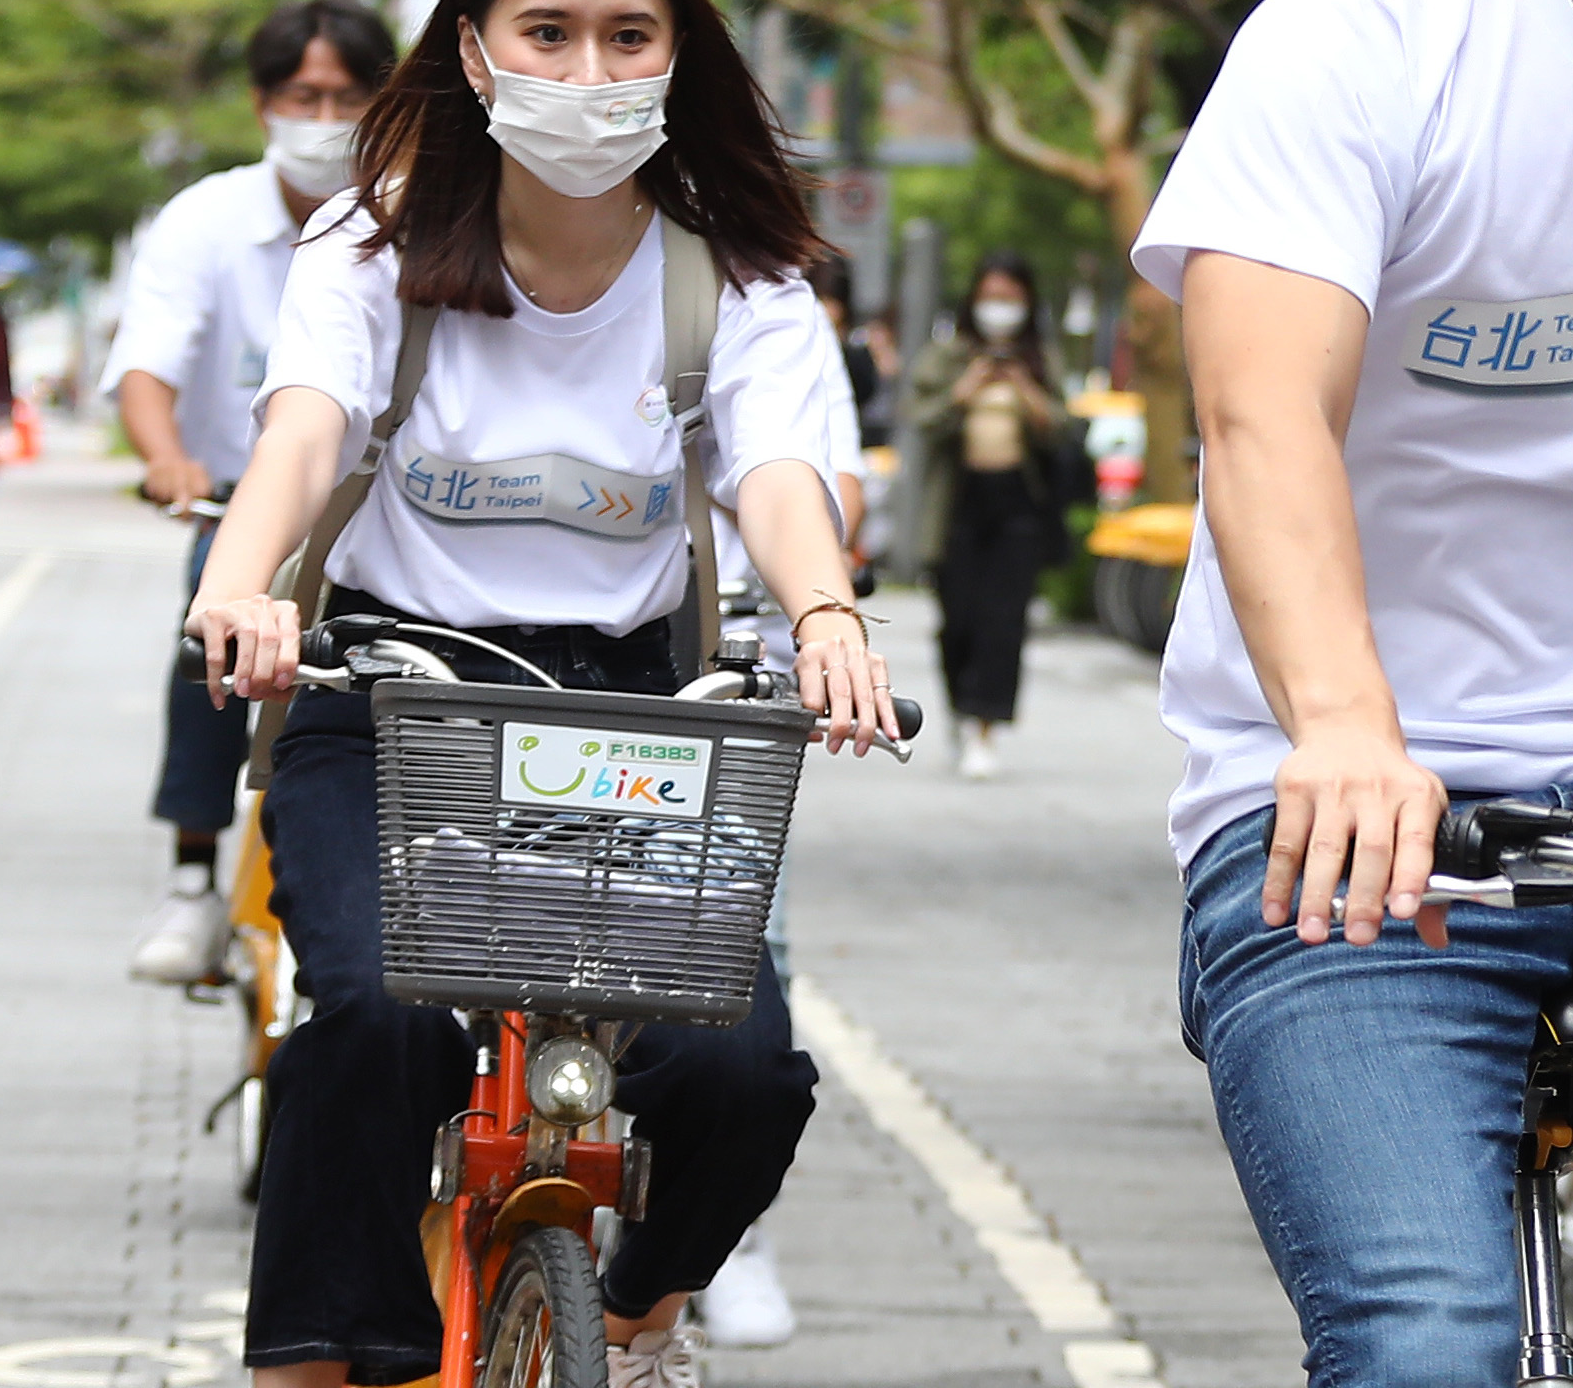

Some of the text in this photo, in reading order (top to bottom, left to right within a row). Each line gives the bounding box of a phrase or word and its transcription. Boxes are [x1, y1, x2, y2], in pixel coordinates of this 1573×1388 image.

[1421, 306, 1543, 372] 台北
[404, 456, 480, 511] 台北
[487, 472, 542, 490] Team
[483, 492, 544, 510] Taipei
[609, 743, 697, 762] F16383
